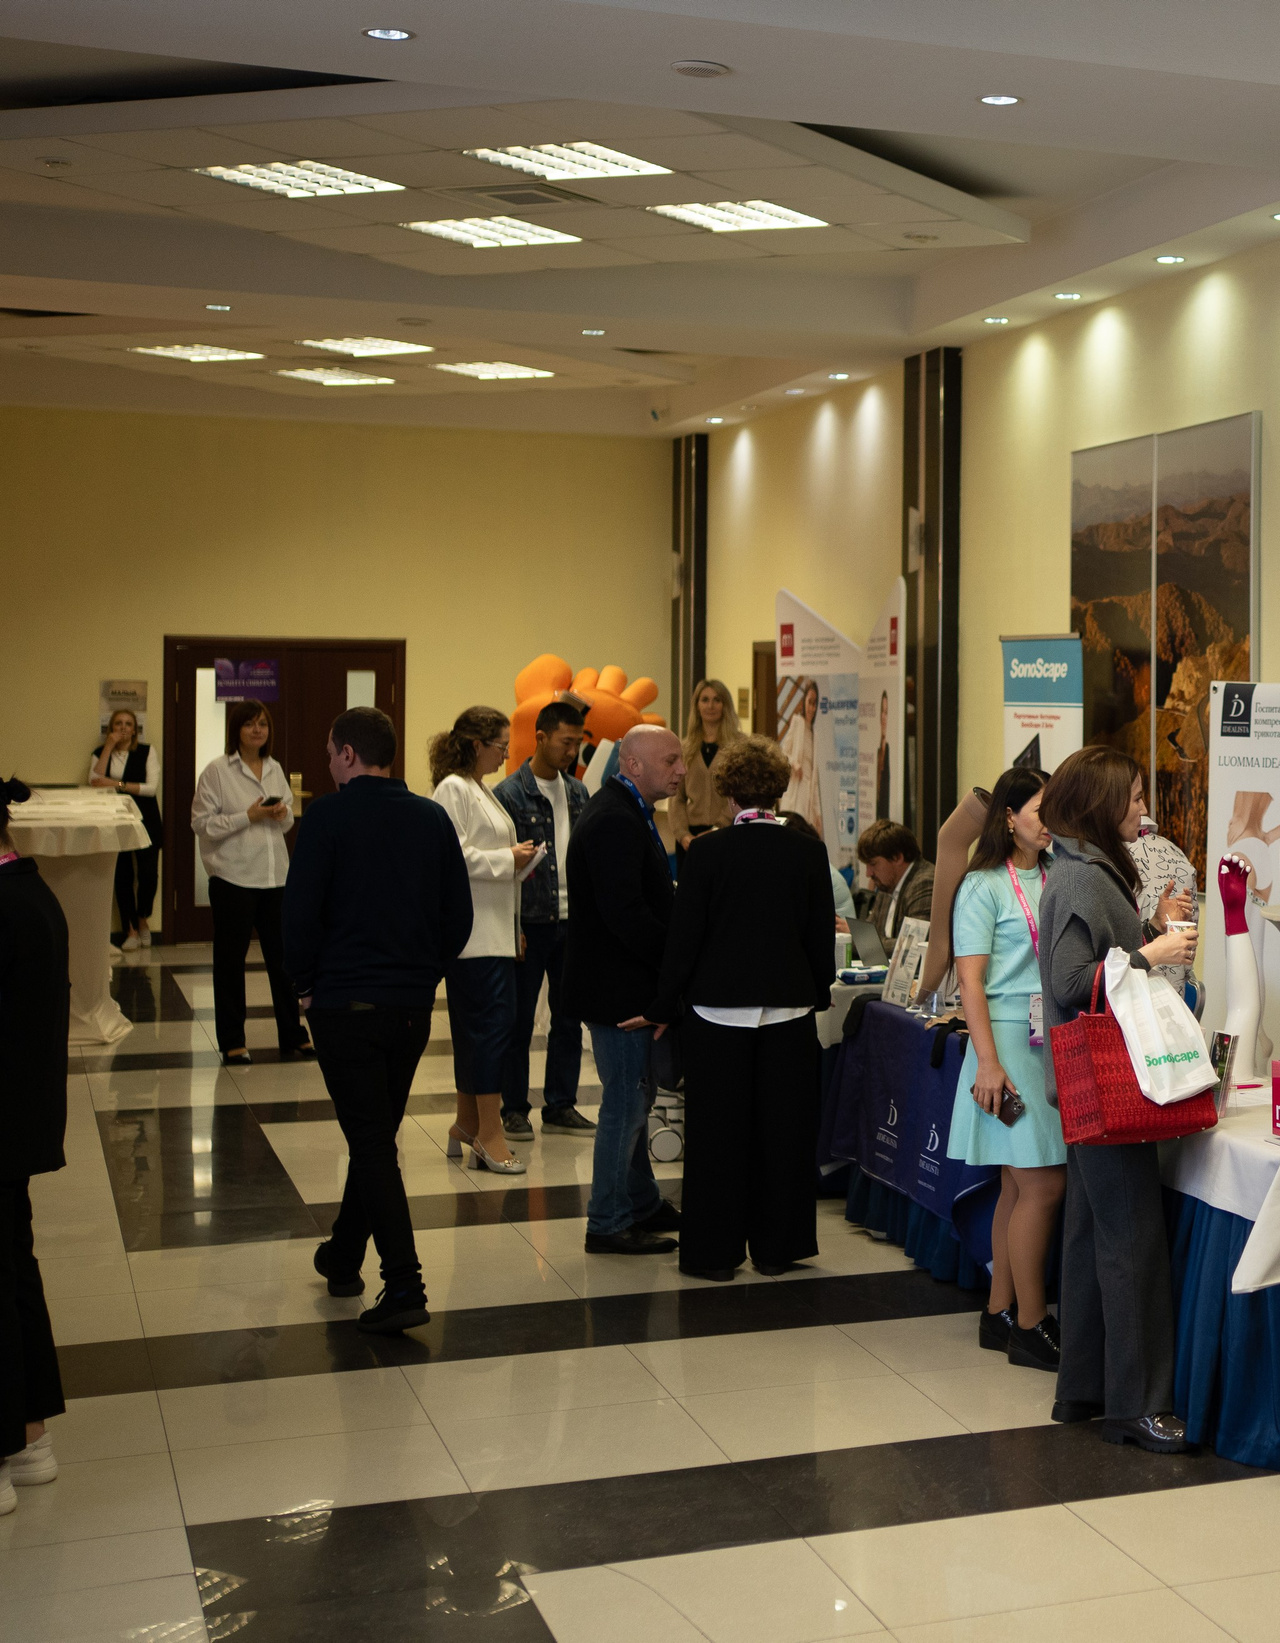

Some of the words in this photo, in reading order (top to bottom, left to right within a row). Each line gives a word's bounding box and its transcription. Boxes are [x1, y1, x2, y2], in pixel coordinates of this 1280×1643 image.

[1010, 658, 1068, 683] SonoScape
[1222, 726, 1249, 734] IDEALISTA
[1218, 756, 1261, 768] LUOMMA
[1145, 1050, 1200, 1067] Sonocape
